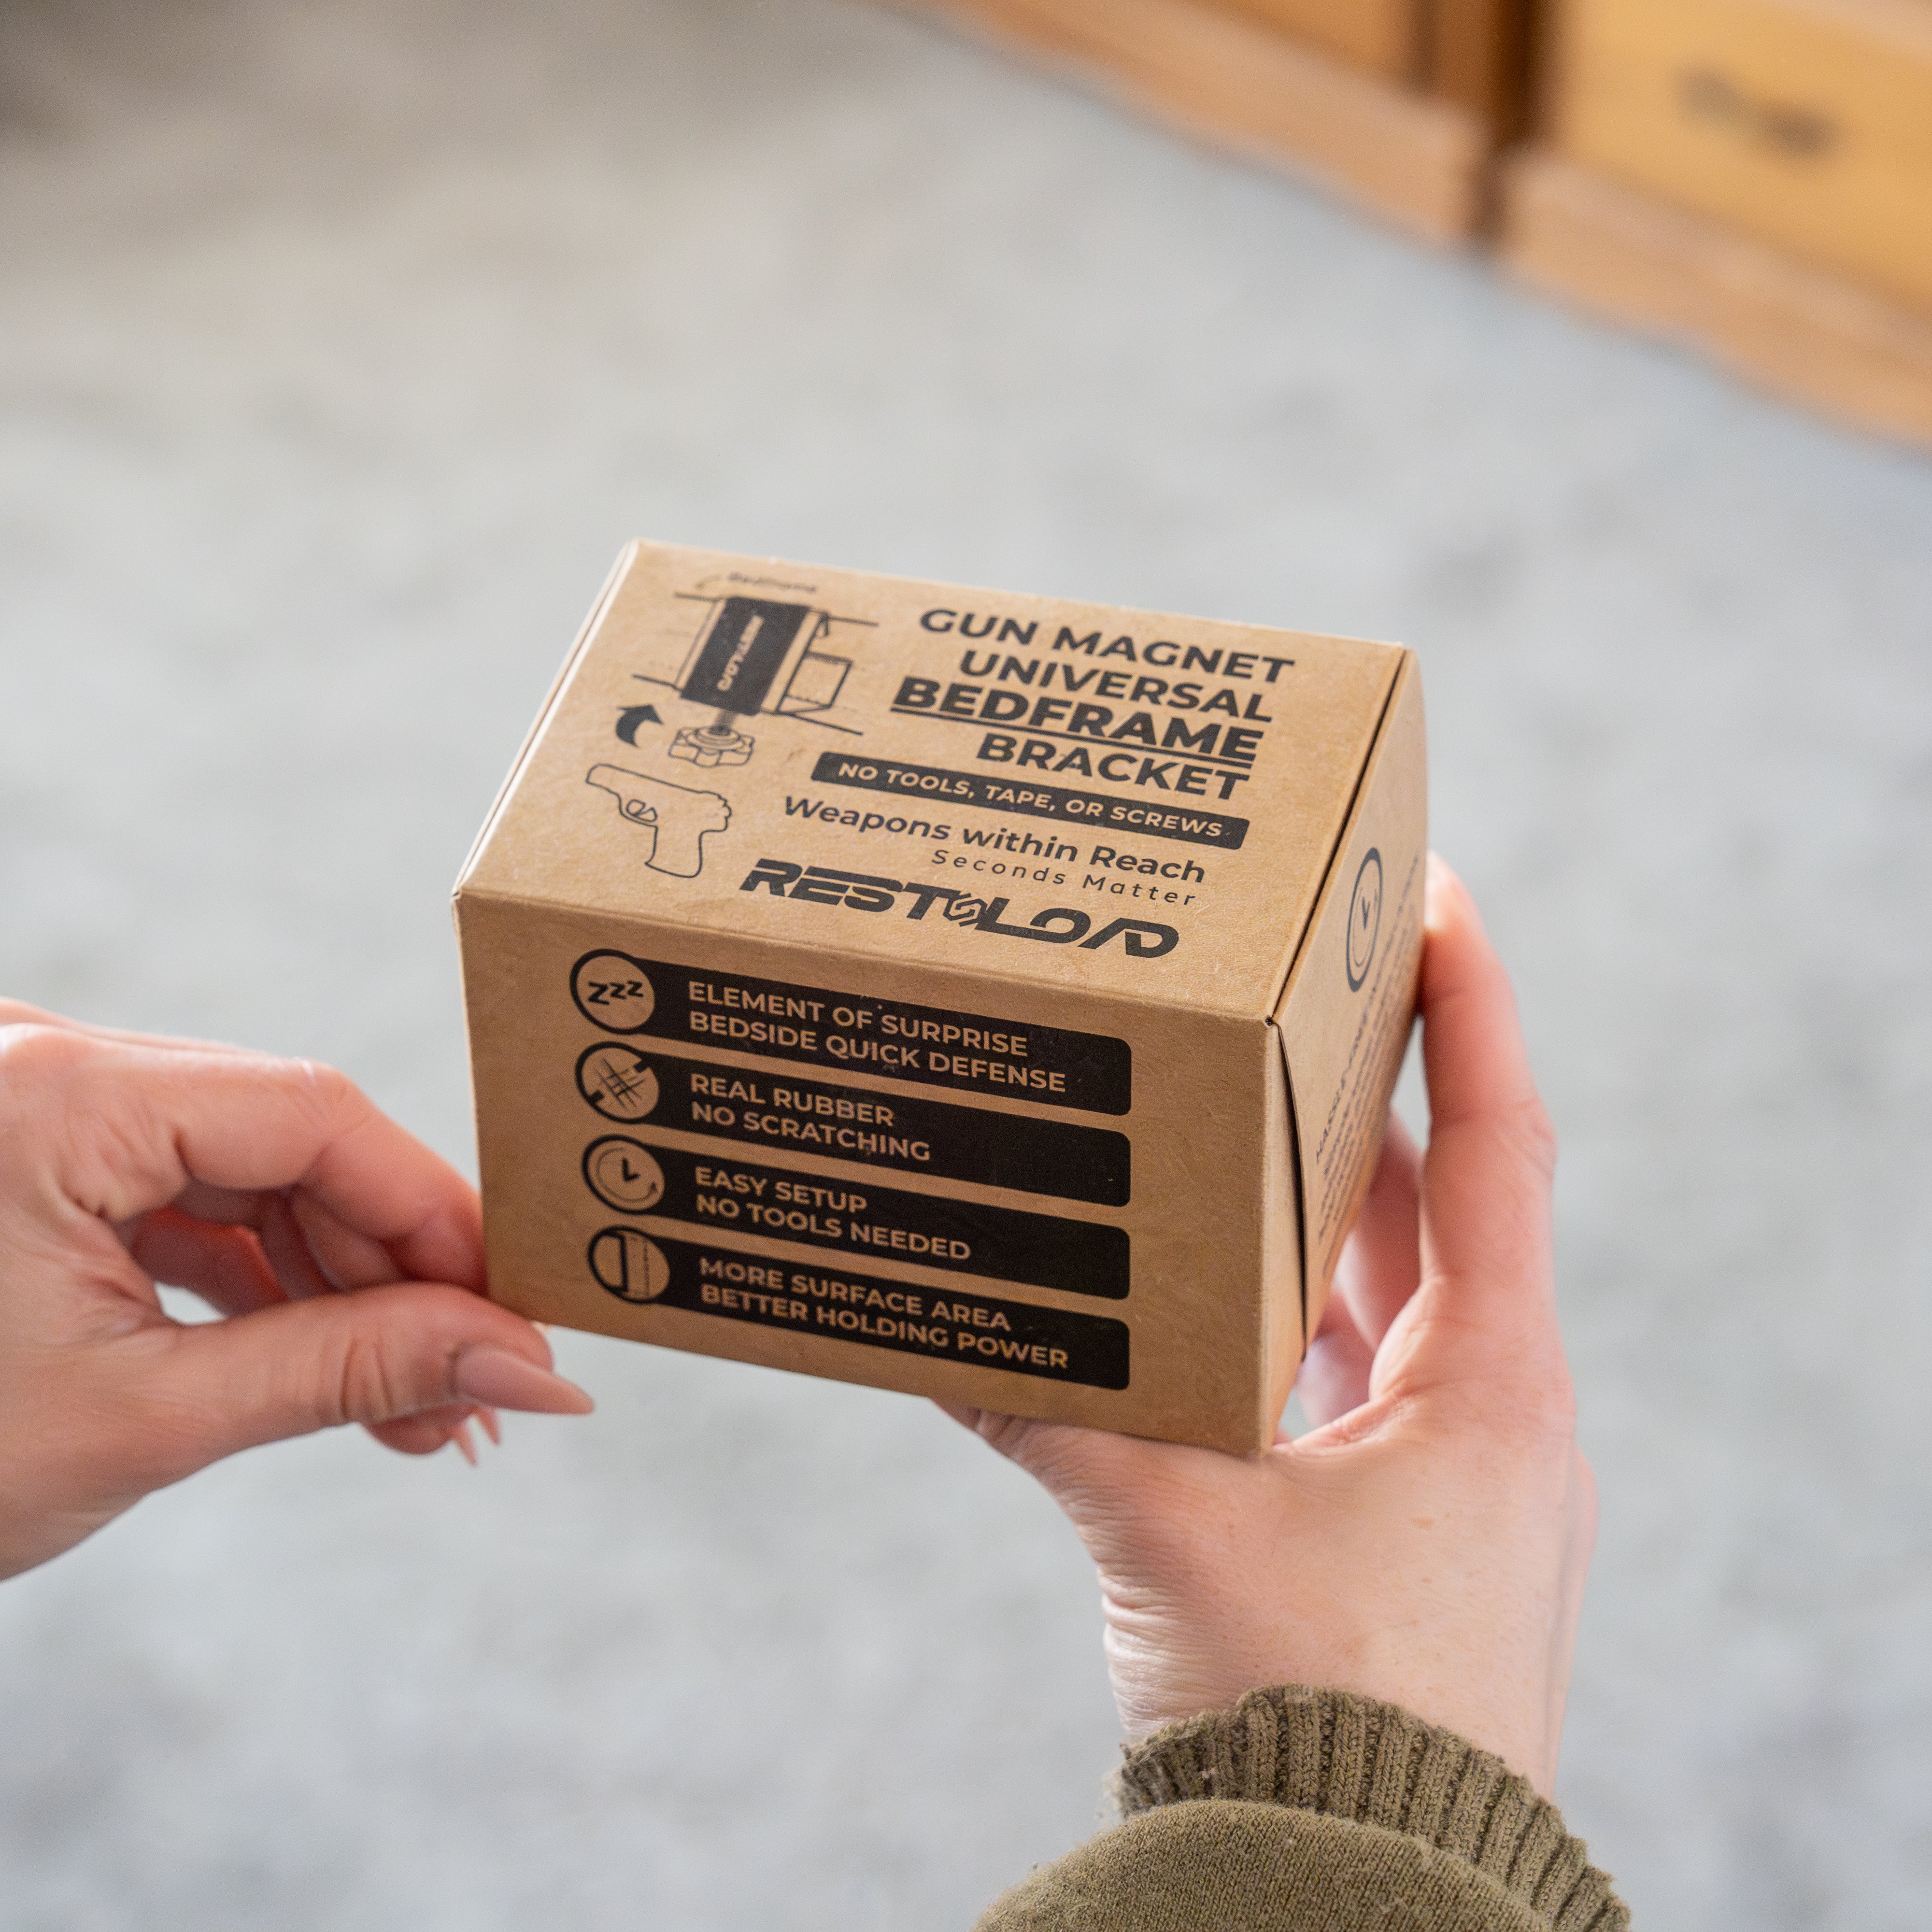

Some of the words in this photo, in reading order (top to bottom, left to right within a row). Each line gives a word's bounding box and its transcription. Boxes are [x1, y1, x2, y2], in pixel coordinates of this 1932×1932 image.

[919, 609, 1037, 646] GUN
[1052, 626, 1294, 683] MAGNET
[893, 676, 1264, 762] BEDFRAME
[959, 650, 1272, 723] UNIVERSAL
[838, 762, 878, 781] NO
[886, 769, 975, 798] TOOLS,
[985, 784, 1057, 812] TAPE,
[1065, 799, 1102, 817] OR
[1109, 808, 1223, 837] SCREWS
[976, 732, 1250, 800] BRACKET
[785, 796, 952, 840] Weapons
[963, 827, 1078, 862] within
[1089, 846, 1206, 883] Reach
[932, 850, 1067, 885] Seconds
[1082, 874, 1196, 906] Matter
[688, 981, 824, 1023] ELEMENT
[832, 1007, 873, 1029] OF
[881, 1014, 1028, 1057] SURPRISE
[690, 1011, 817, 1051] BEDSIDE
[826, 1035, 920, 1068] QUICK
[929, 1052, 1065, 1093] DEFENSE
[691, 1073, 766, 1105] REAL
[773, 1088, 895, 1127] RUBBER
[692, 1102, 735, 1126] NO
[744, 1112, 930, 1161] SCRATCHING
[695, 1166, 767, 1196] EASY
[775, 1181, 867, 1213] SETUP
[696, 1194, 739, 1218] NO
[746, 1203, 842, 1238] TOOLS
[850, 1222, 971, 1260] NEEDED
[699, 1257, 784, 1290] MORE
[791, 1274, 923, 1315] SURFACE
[931, 1301, 1011, 1332] AREA
[701, 1284, 808, 1321] BETTER
[816, 1306, 949, 1347] HOLDING
[957, 1332, 1069, 1369] POWER
